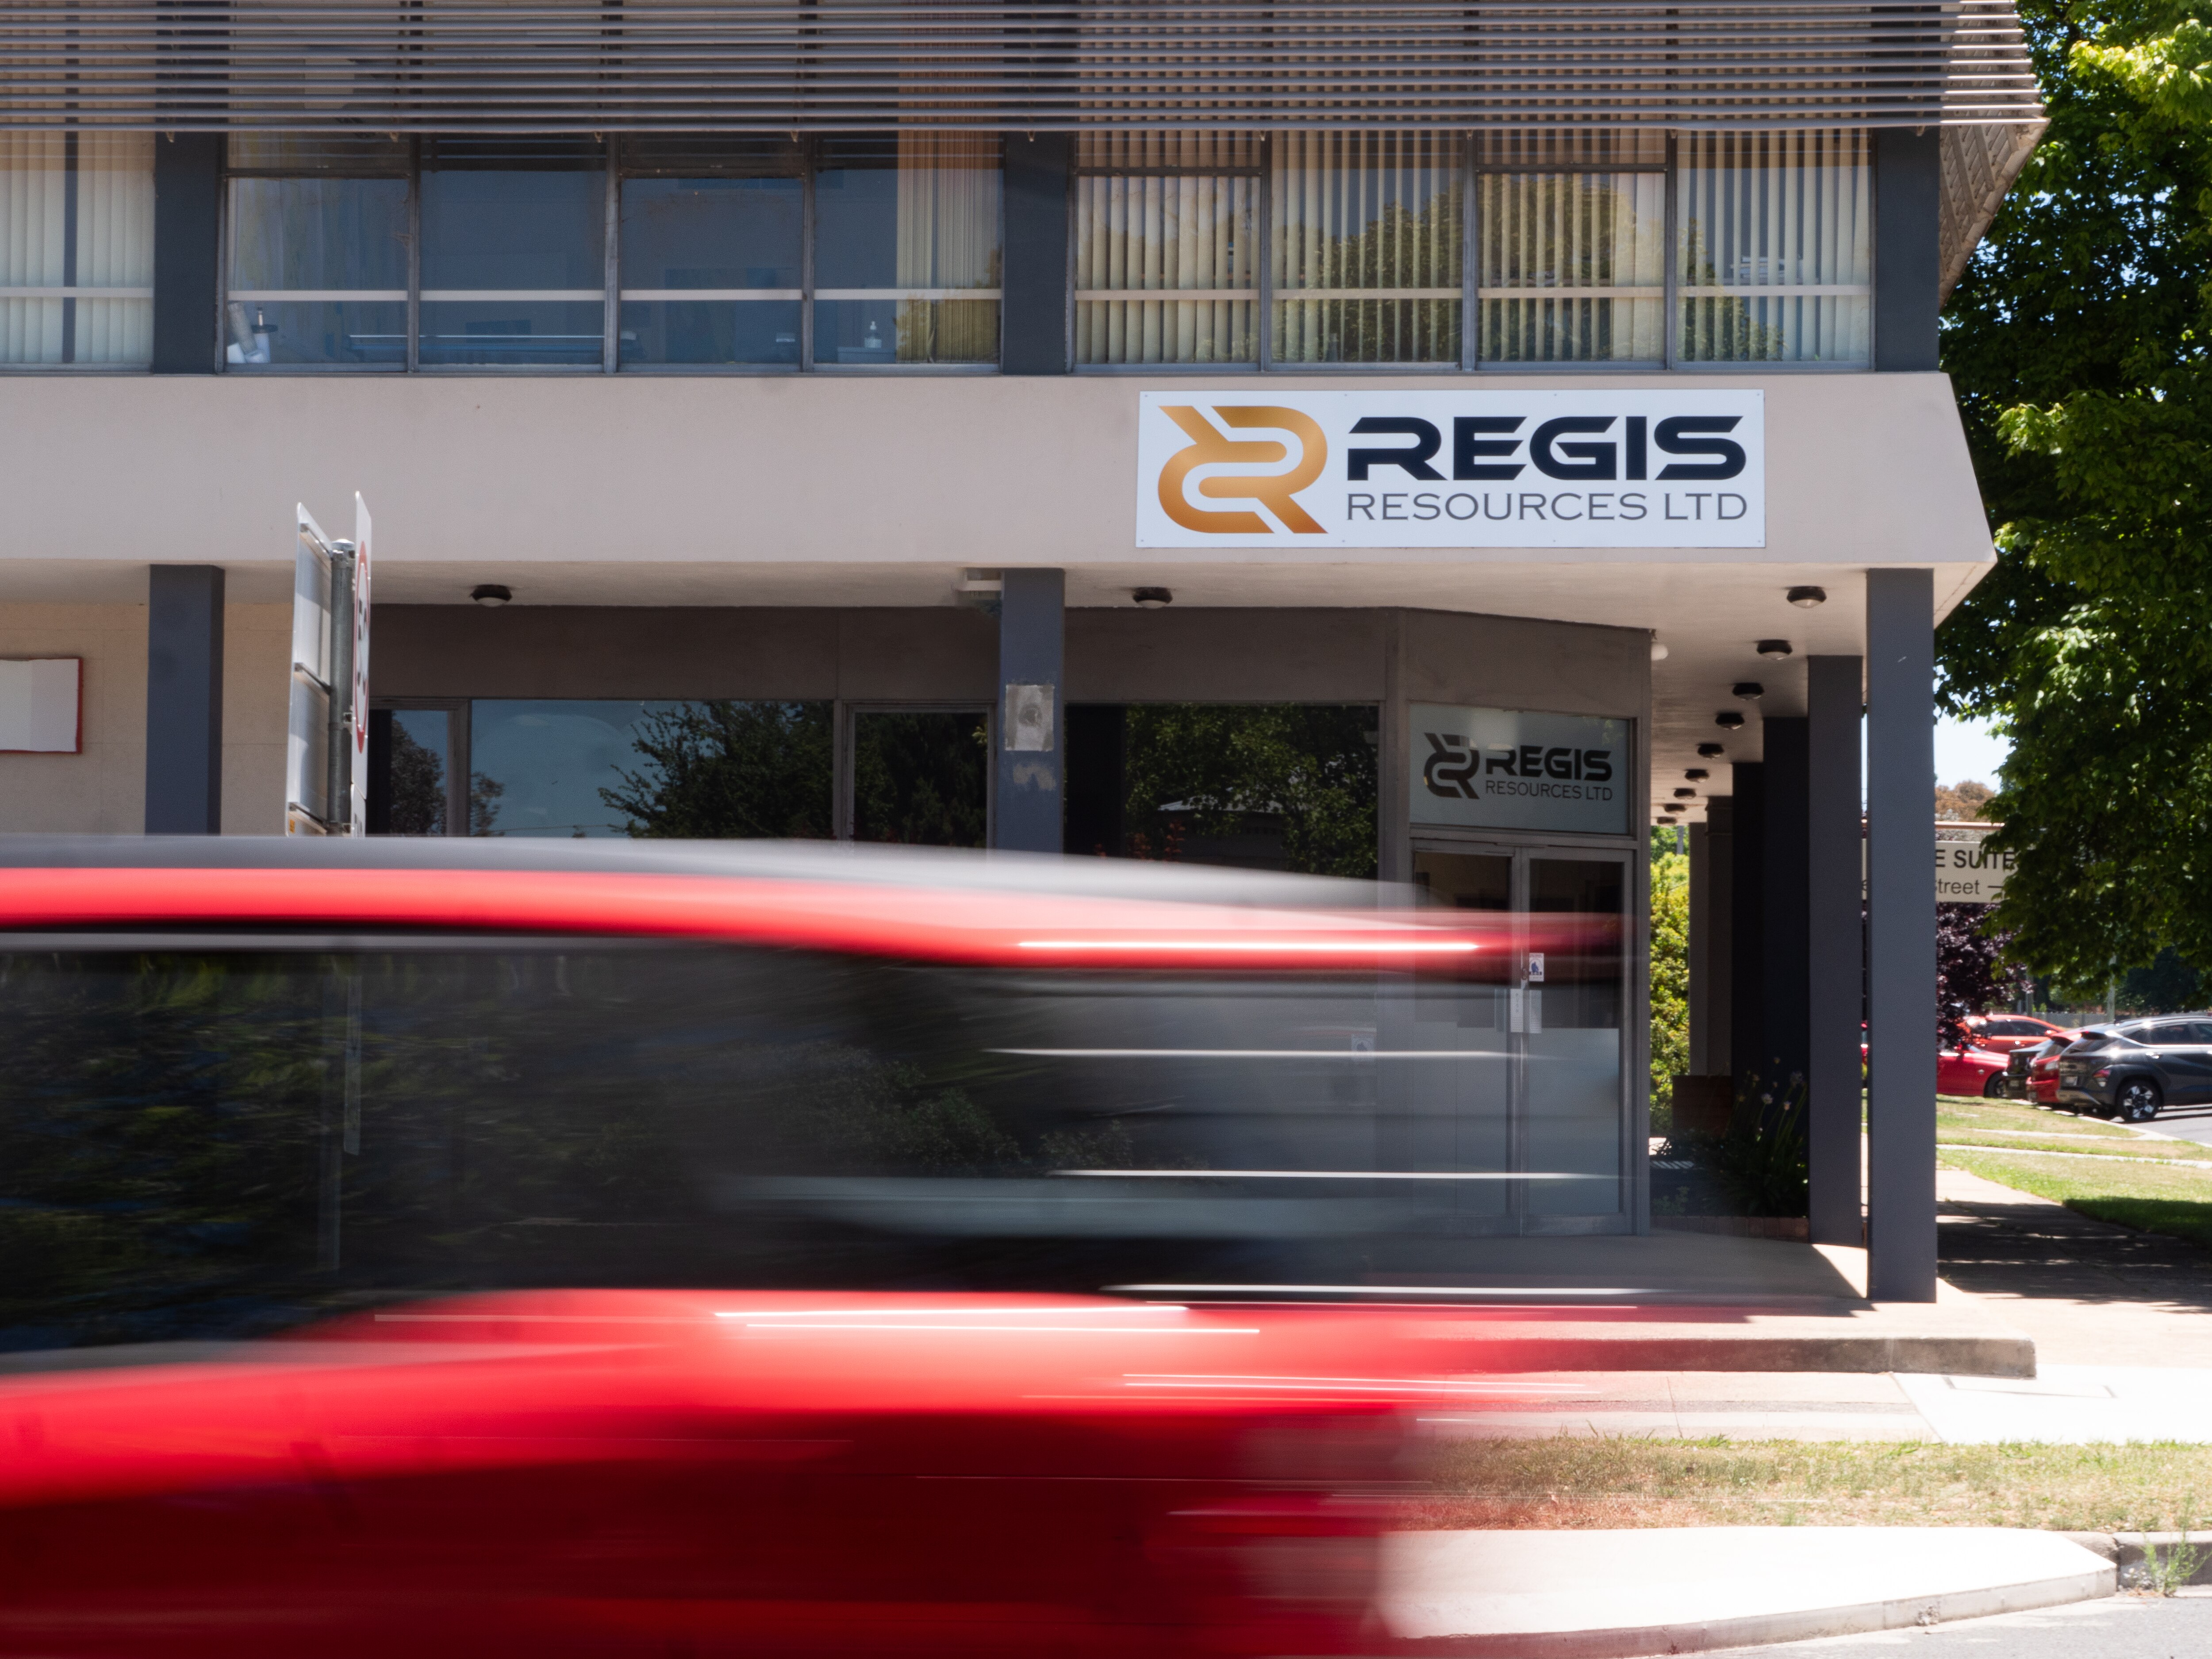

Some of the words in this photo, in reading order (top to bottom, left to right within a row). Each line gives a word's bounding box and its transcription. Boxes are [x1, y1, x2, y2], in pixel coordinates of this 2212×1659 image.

[1347, 415, 1747, 481] REGIS
[1347, 492, 1648, 521] RESOURCES
[1664, 492, 1747, 521] LTD
[1486, 744, 1613, 782] REGIS
[1486, 780, 1582, 799] RESOURCES
[1586, 786, 1613, 801] LTD
[1936, 878, 1980, 895] treet
